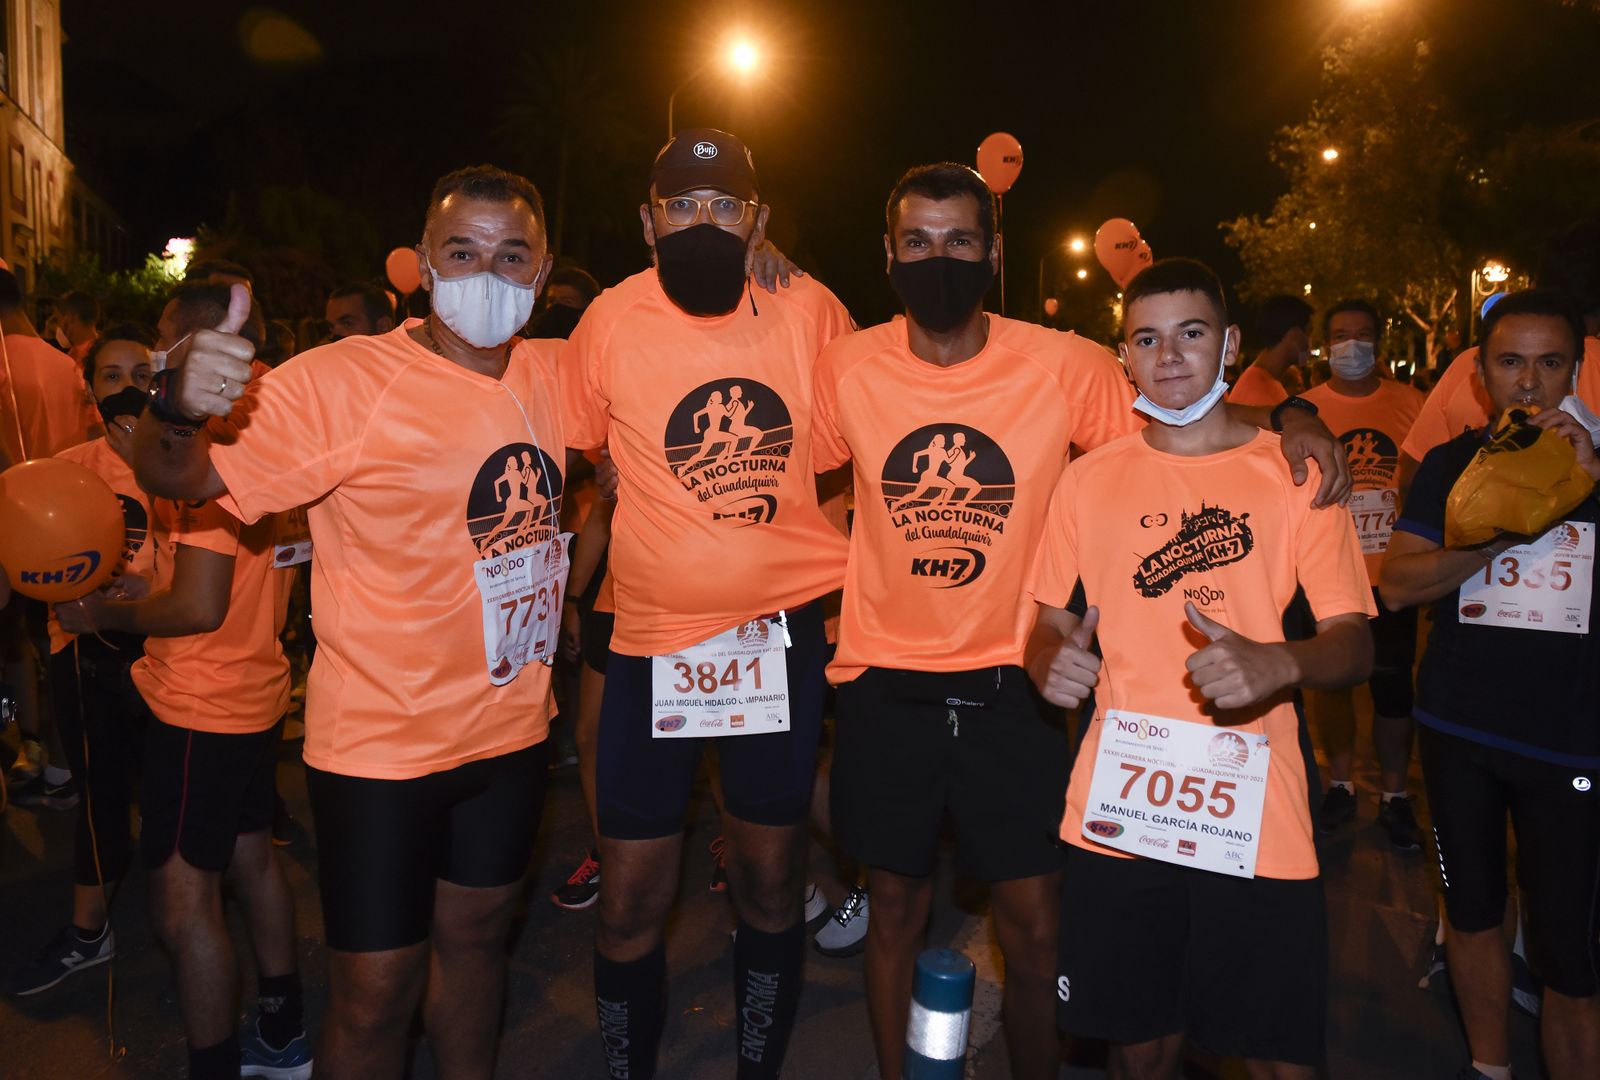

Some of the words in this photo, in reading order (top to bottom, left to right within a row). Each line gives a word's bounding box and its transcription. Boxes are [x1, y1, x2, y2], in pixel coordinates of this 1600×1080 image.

[696, 145, 715, 156] Buff
[681, 476, 702, 491] LA
[703, 459, 786, 481] NOCTURNA
[697, 487, 713, 503] del
[712, 475, 779, 496] Guadalquivir
[891, 513, 912, 528] LA
[915, 509, 1004, 534] NOCTURNA
[905, 527, 921, 542] del
[921, 525, 992, 547] Guadalquivir
[1139, 558, 1163, 578] LA
[1160, 522, 1244, 566] NOCTURNA
[1145, 552, 1204, 586] GUADALQUIVIR
[500, 580, 559, 635] 7731
[673, 656, 763, 694] 3841
[654, 699, 675, 707] JUAN
[675, 698, 703, 707] MIGUEL
[704, 697, 737, 706] HIDALGO
[1119, 762, 1236, 819] 7055
[1099, 803, 1149, 821] MANUEL
[1152, 814, 1199, 832] GARCÍA
[1201, 823, 1253, 842] ROJANO
